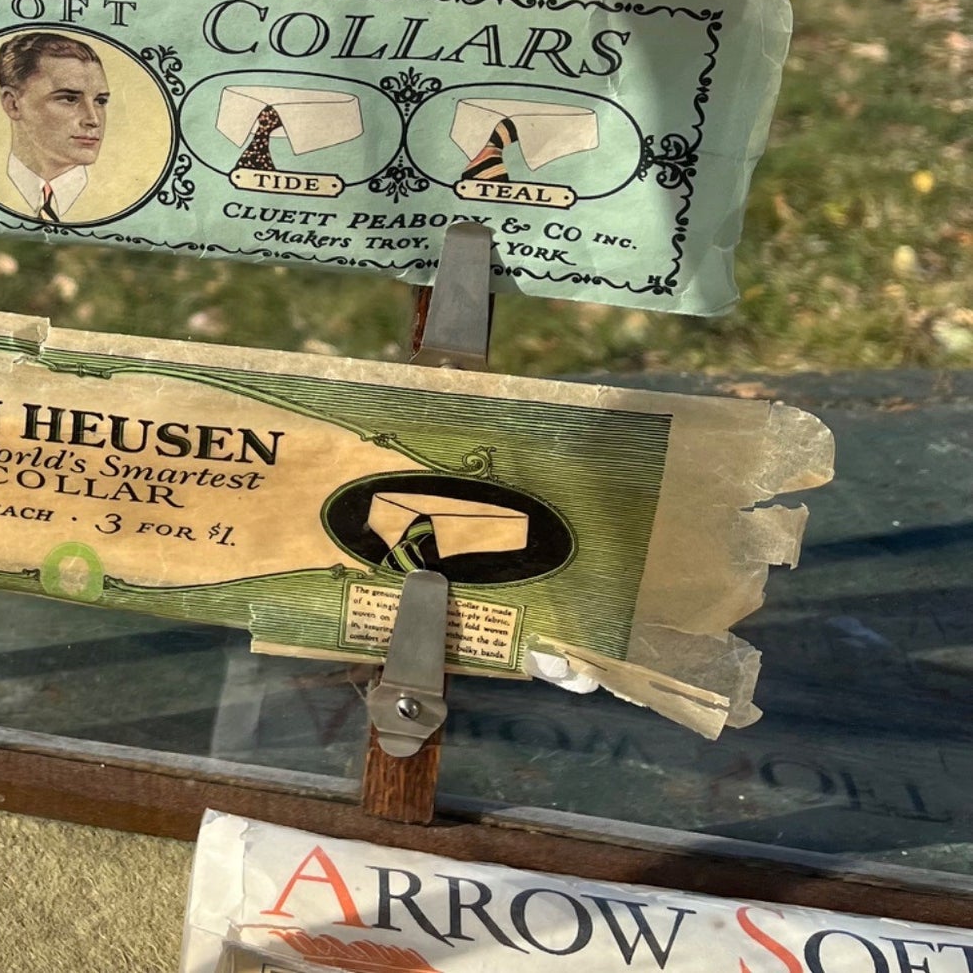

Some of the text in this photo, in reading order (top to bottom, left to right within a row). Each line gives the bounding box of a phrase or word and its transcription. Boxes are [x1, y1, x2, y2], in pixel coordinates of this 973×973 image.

[202, 0, 632, 79] COLLARS
[254, 173, 320, 191] TIDE
[476, 183, 552, 203] TEAL
[222, 201, 337, 227] CLUETT
[501, 217, 531, 235] &
[543, 222, 583, 242] CO
[592, 232, 639, 250] INC.
[253, 228, 353, 249] Makers
[506, 241, 577, 266] YORK
[21, 403, 285, 466] HEUSEN
[99, 454, 265, 492] Smartest
[94, 513, 123, 535] 3
[135, 522, 197, 542] FOR
[207, 522, 237, 547] $1.
[355, 586, 369, 594] The
[454, 600, 479, 610] Collar
[491, 608, 512, 616] made
[260, 844, 697, 971] ARROW
